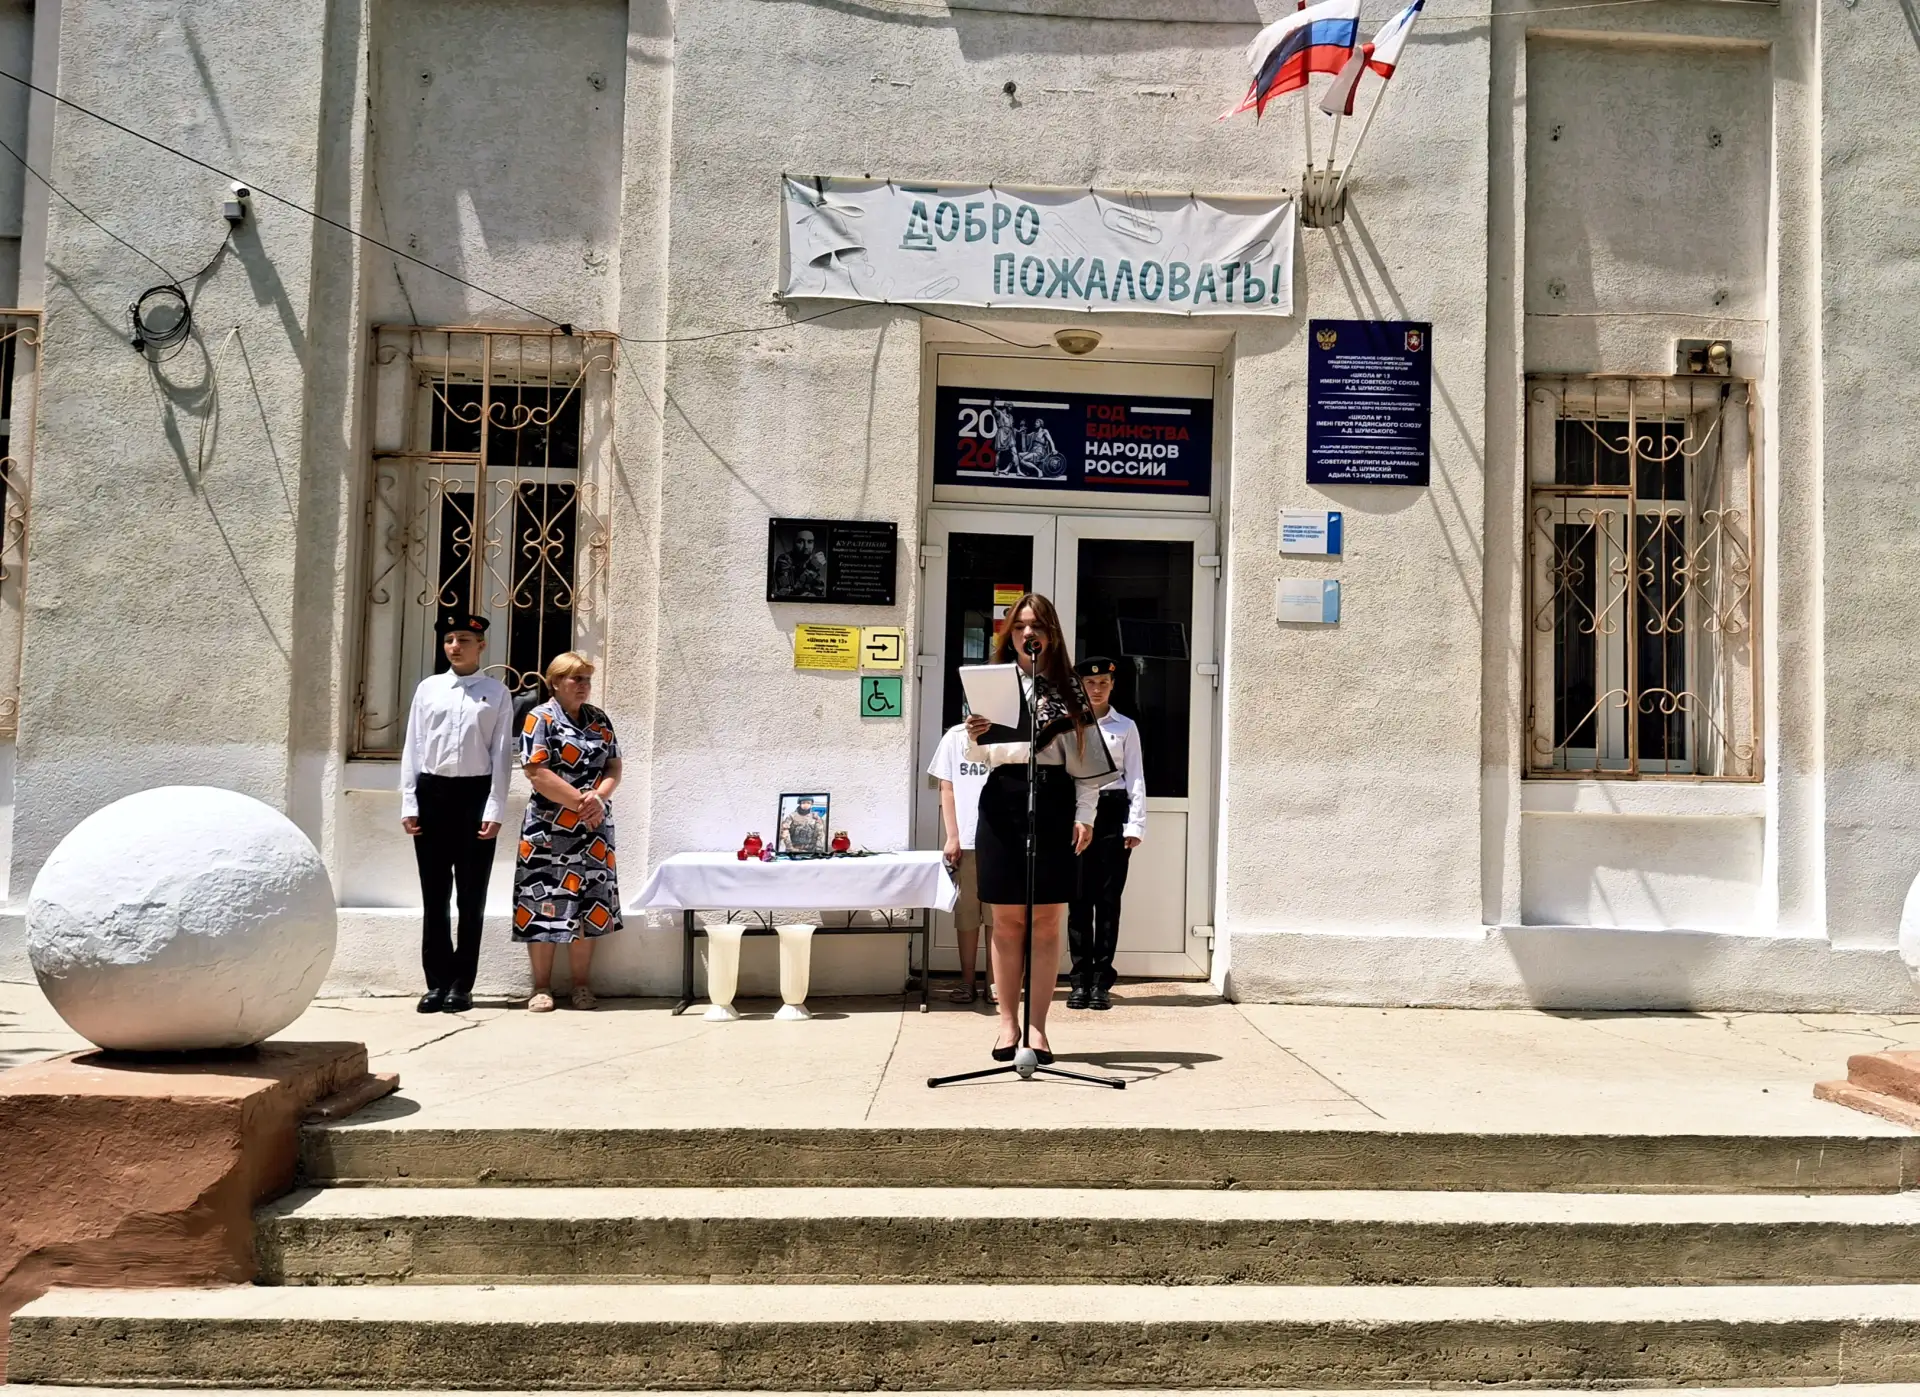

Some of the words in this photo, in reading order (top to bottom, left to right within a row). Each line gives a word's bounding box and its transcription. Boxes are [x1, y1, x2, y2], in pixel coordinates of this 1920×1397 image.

[899, 199, 1040, 251] ДОБРО
[993, 253, 1281, 304] ПОЖАЛОВАТЬ!
[958, 408, 998, 438] 20
[1086, 405, 1125, 423] ГОД
[1086, 423, 1189, 441] ЕДИНСТВА
[957, 438, 996, 468] 26
[1085, 442, 1179, 460] НАРОДОВ
[1084, 459, 1166, 476] РОССИИ
